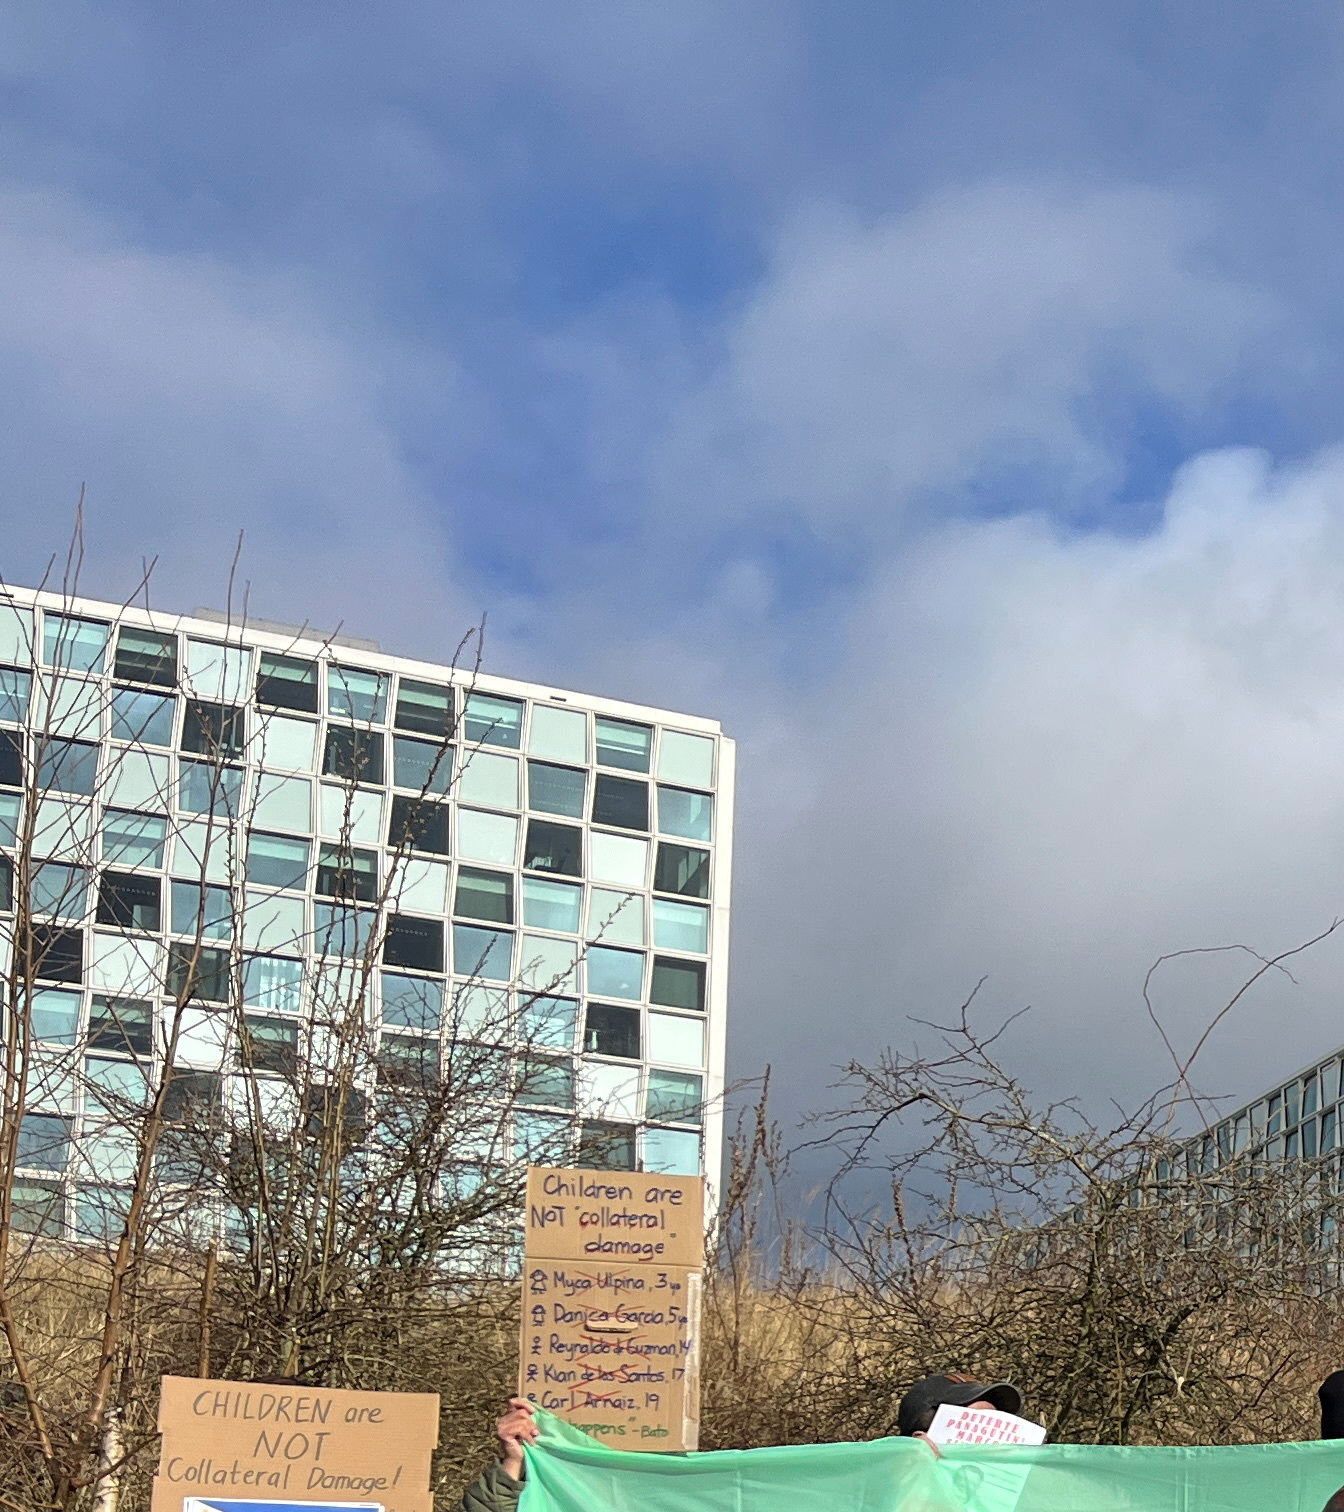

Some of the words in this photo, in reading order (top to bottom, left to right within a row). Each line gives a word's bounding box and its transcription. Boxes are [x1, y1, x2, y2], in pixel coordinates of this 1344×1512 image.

[543, 1174, 632, 1200] Children
[645, 1187, 683, 1206] are
[193, 1389, 332, 1424] CHILDREN
[344, 1406, 385, 1424] are
[253, 1430, 330, 1461] NOT
[167, 1457, 291, 1490] Collateral
[306, 1465, 403, 1497] Damage!
